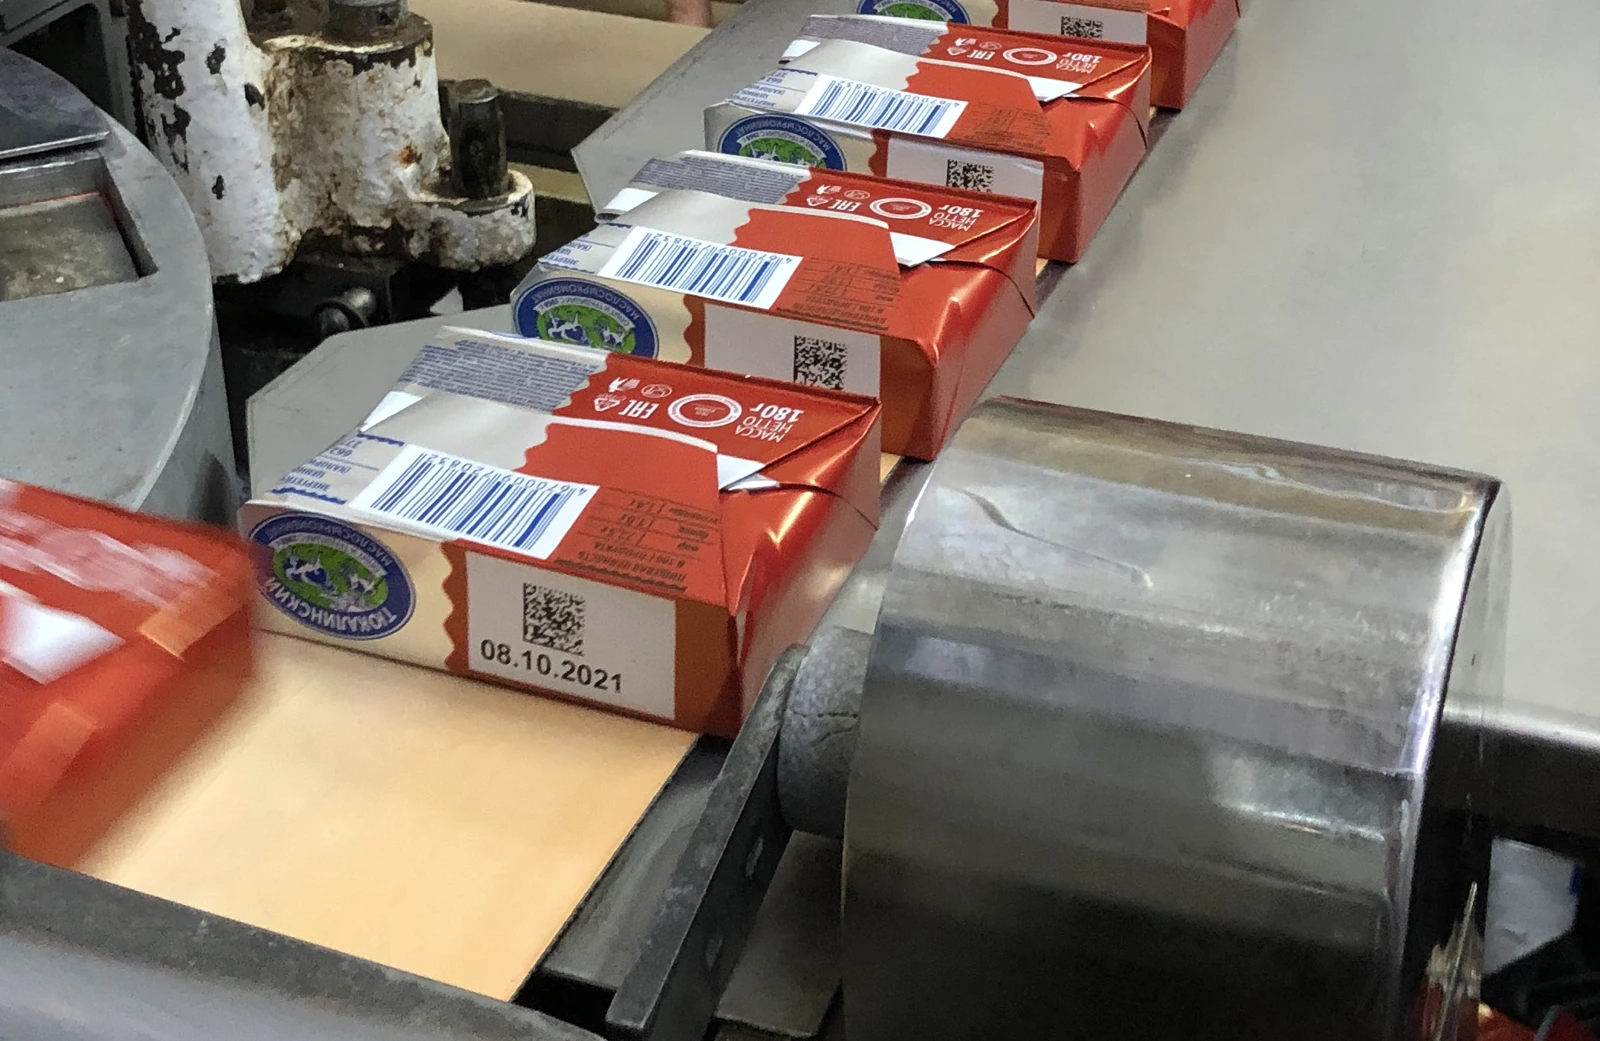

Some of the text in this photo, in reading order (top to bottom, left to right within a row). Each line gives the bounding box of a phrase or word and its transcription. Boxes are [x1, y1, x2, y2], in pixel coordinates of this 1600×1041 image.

[734, 118, 831, 151] МАСЛОСЫРКОМБИНАТ
[933, 212, 977, 226] НЕТТО
[937, 204, 985, 218] 180г
[928, 217, 971, 232] МАССА
[530, 284, 641, 321] МАСЛОСЫРКОМБИНАТ
[750, 403, 804, 423] 180г
[735, 424, 786, 443] МАССА
[743, 416, 793, 434] НЕТТО
[480, 639, 622, 694] 08.10.2021
